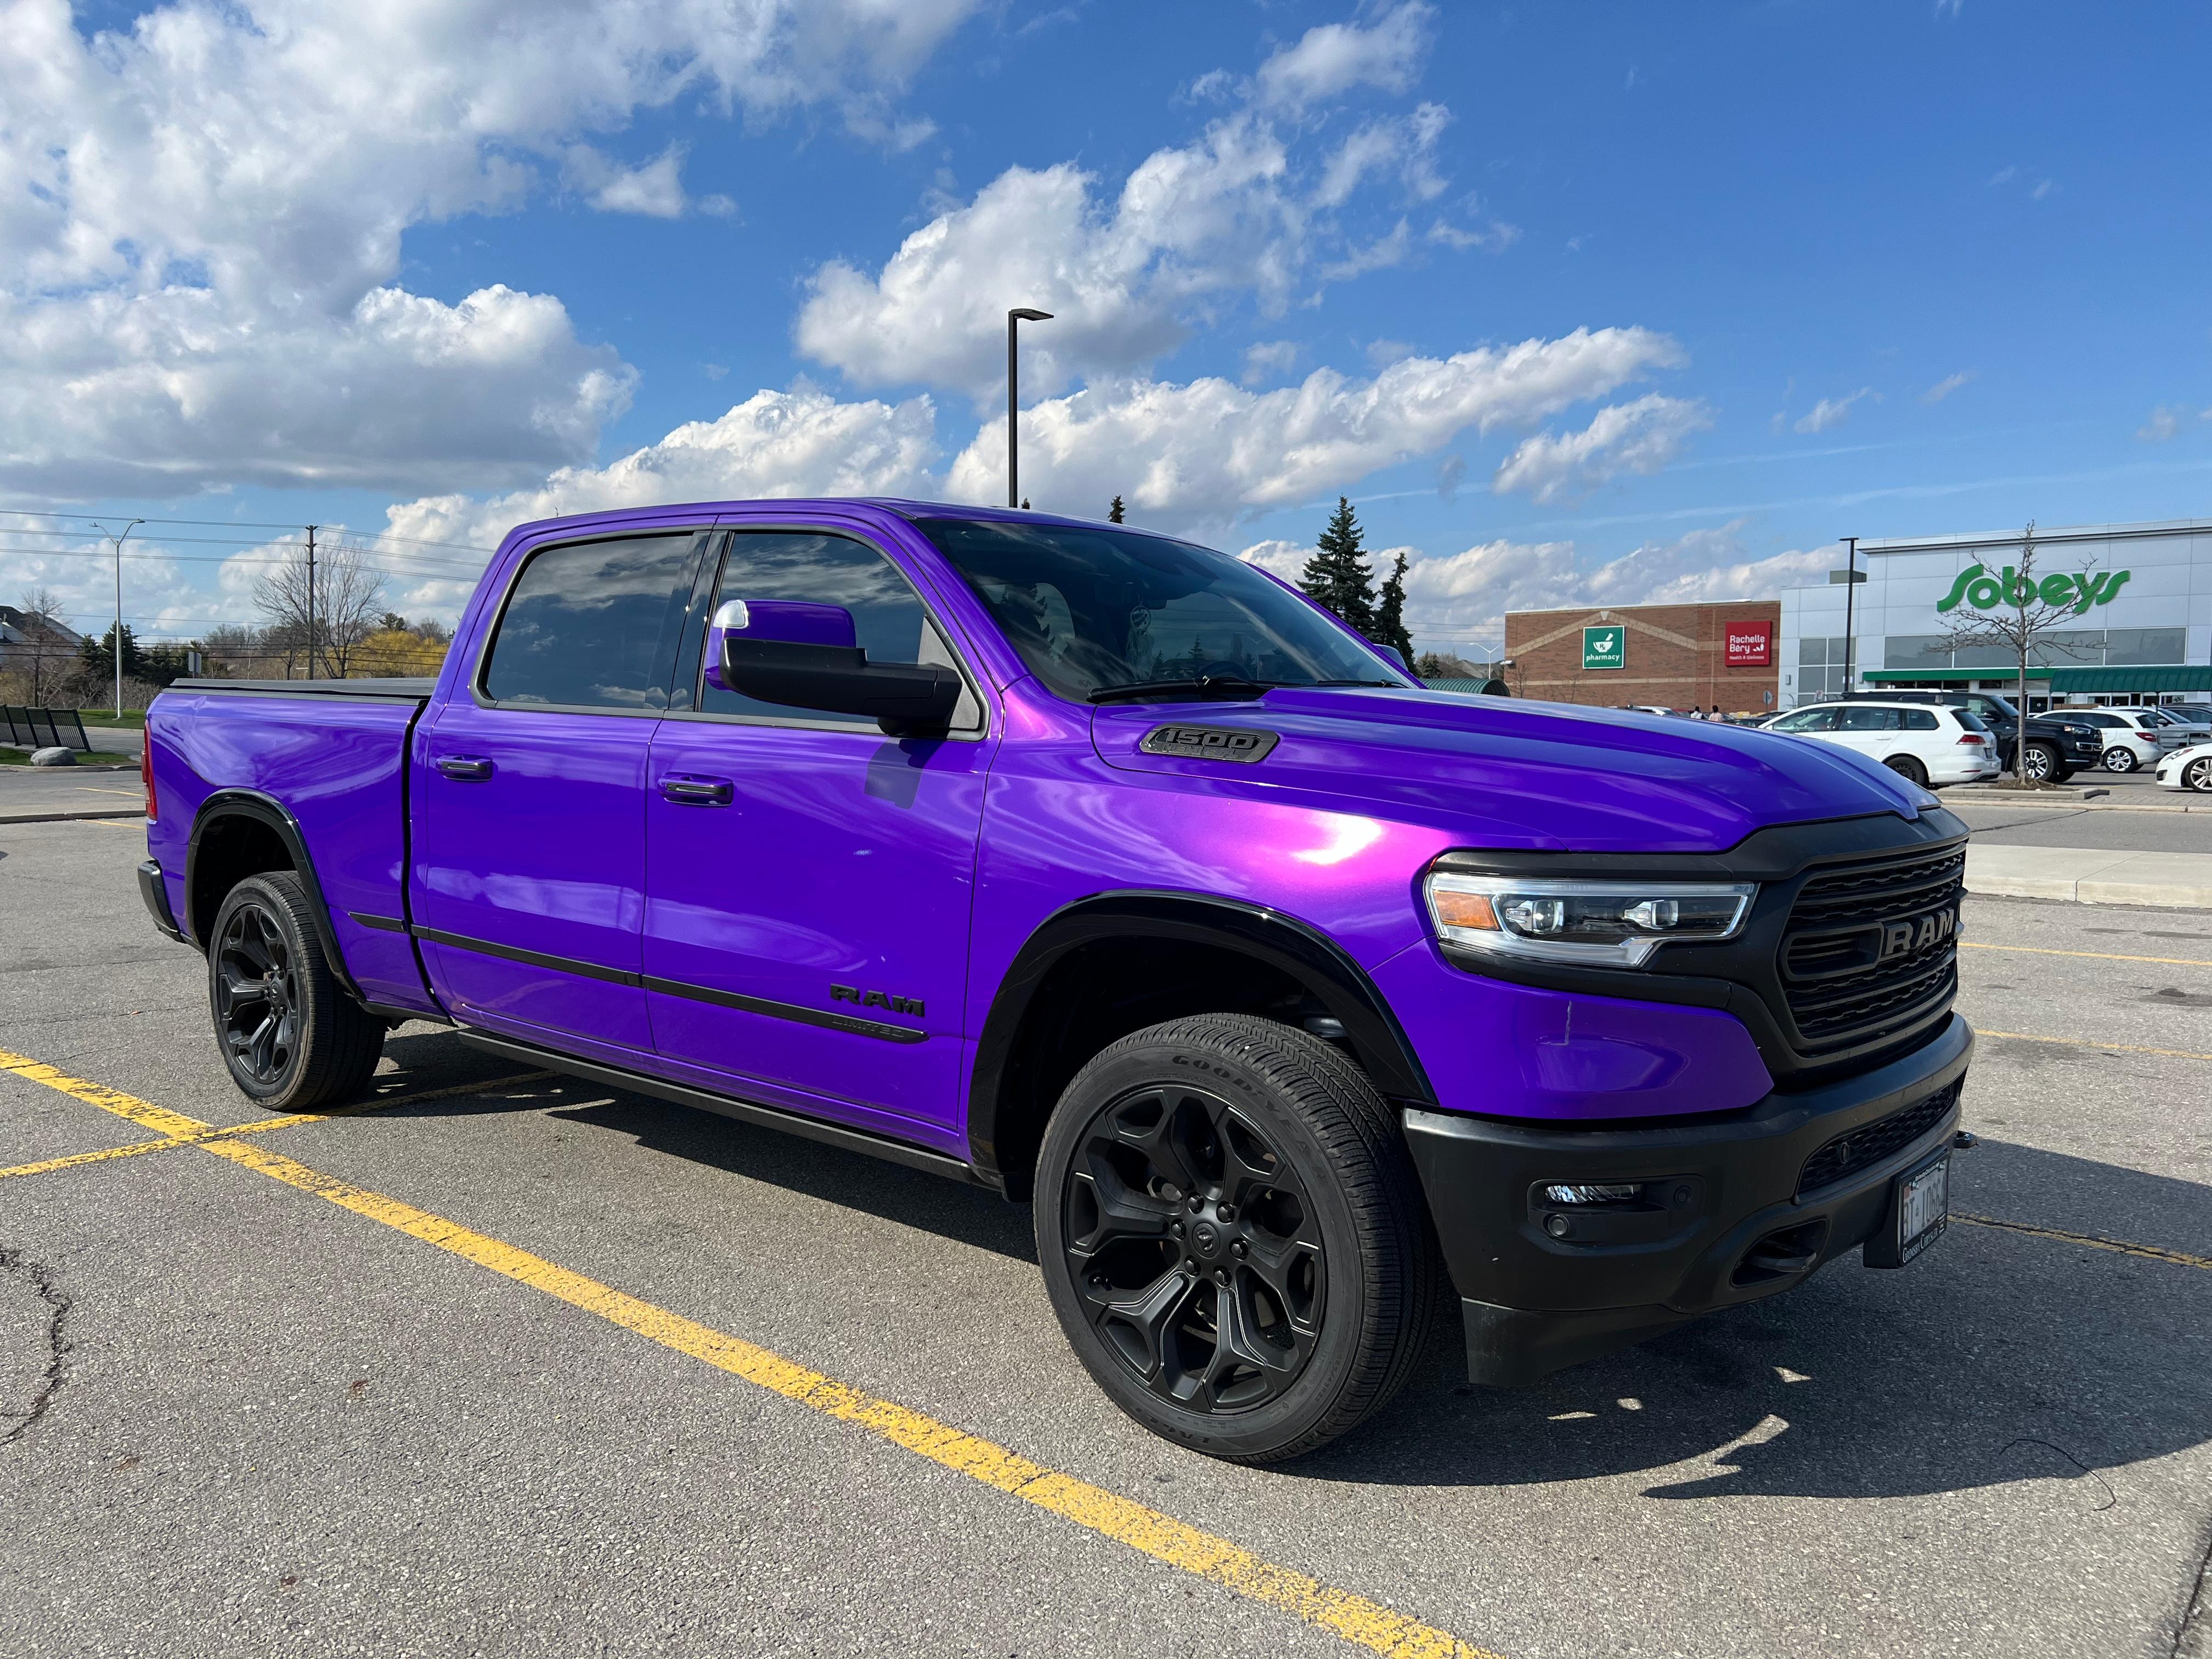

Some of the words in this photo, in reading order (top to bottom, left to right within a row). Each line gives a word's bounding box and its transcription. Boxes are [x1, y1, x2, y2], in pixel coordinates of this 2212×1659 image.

[1937, 564, 2130, 614] Sobeys
[1729, 634, 1765, 644] Rachelle
[1586, 653, 1620, 663] pharmacy
[1163, 743, 1203, 755] HEMI
[1166, 729, 1254, 748] 1500
[1884, 907, 1955, 955] RAM
[830, 983, 925, 1017] RAM
[831, 1015, 905, 1038] LIMITED
